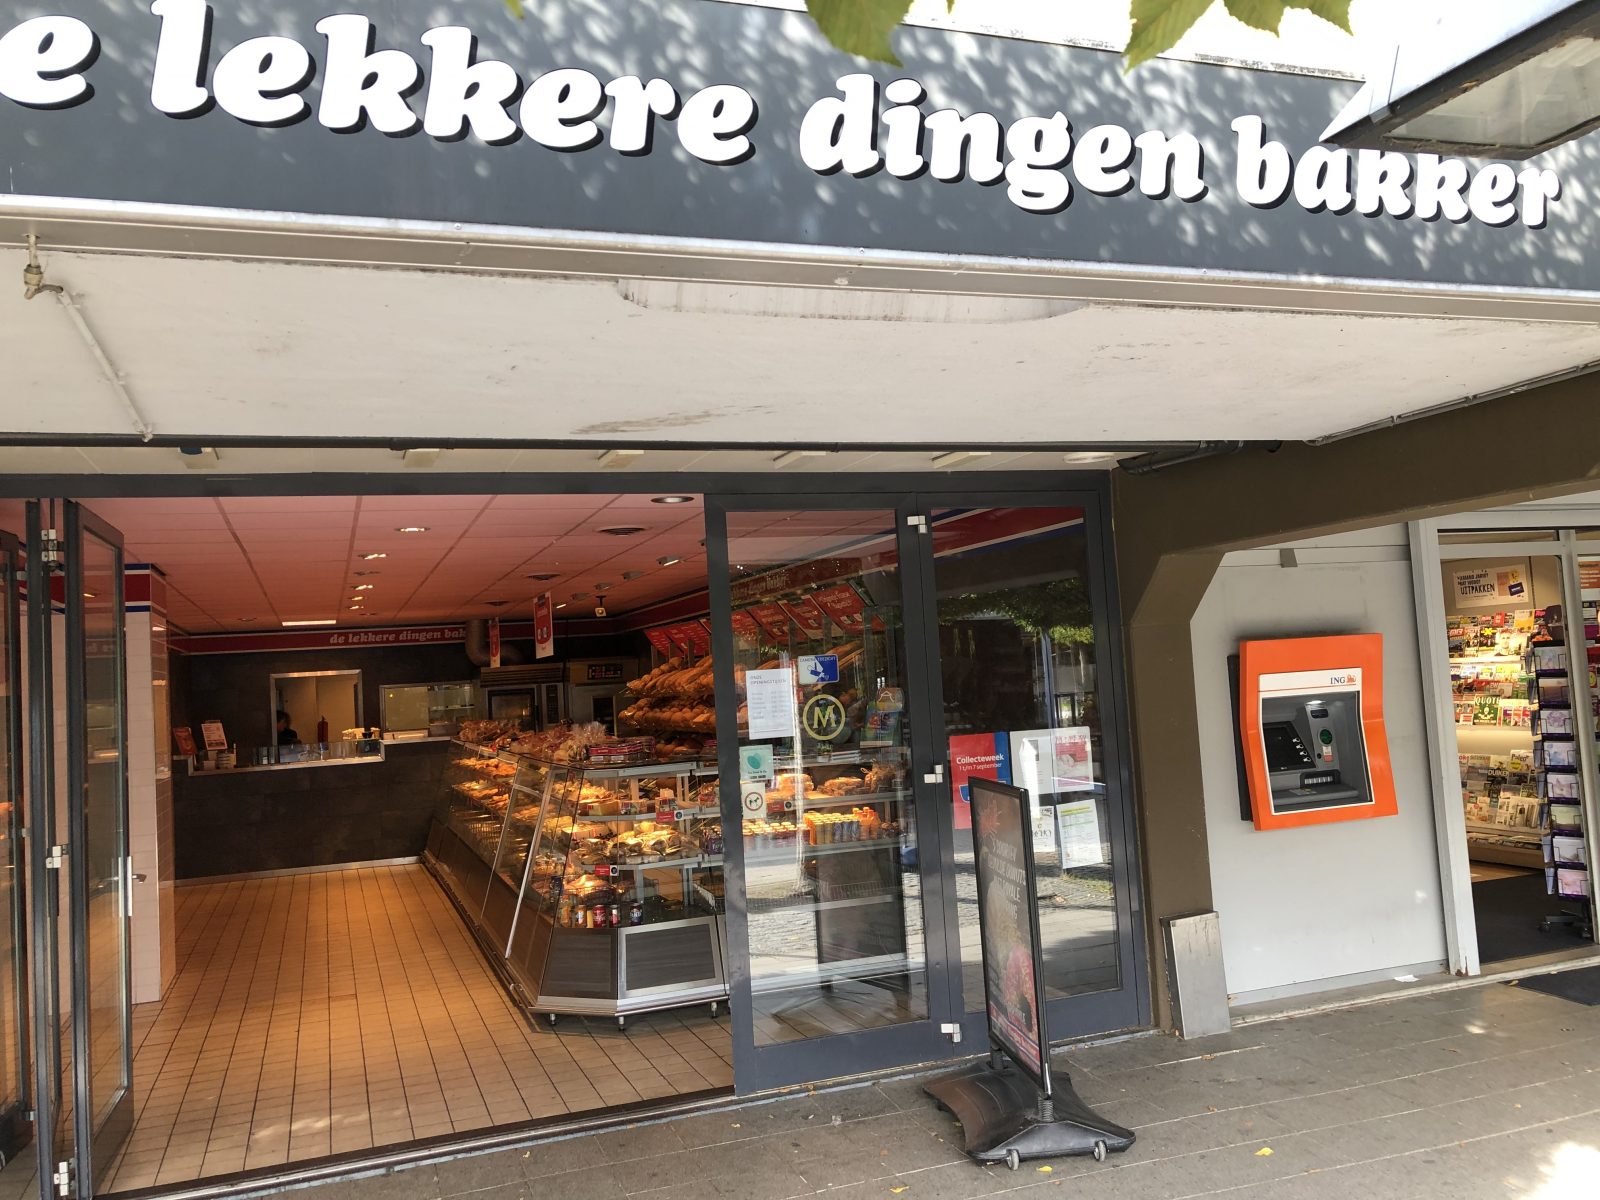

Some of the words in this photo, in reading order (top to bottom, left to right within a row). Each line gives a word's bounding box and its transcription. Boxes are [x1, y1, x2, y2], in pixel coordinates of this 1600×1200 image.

[150, 0, 758, 166] lekkere
[800, 73, 1207, 214] dingen
[1232, 114, 1562, 229] bakker
[1460, 584, 1495, 595] UITPAKKEN
[329, 634, 345, 644] de
[348, 632, 396, 643] lekkere
[398, 630, 441, 641] dingen
[1330, 676, 1346, 685] ING
[956, 753, 1005, 764] Collecteweek
[976, 762, 1002, 770] september
